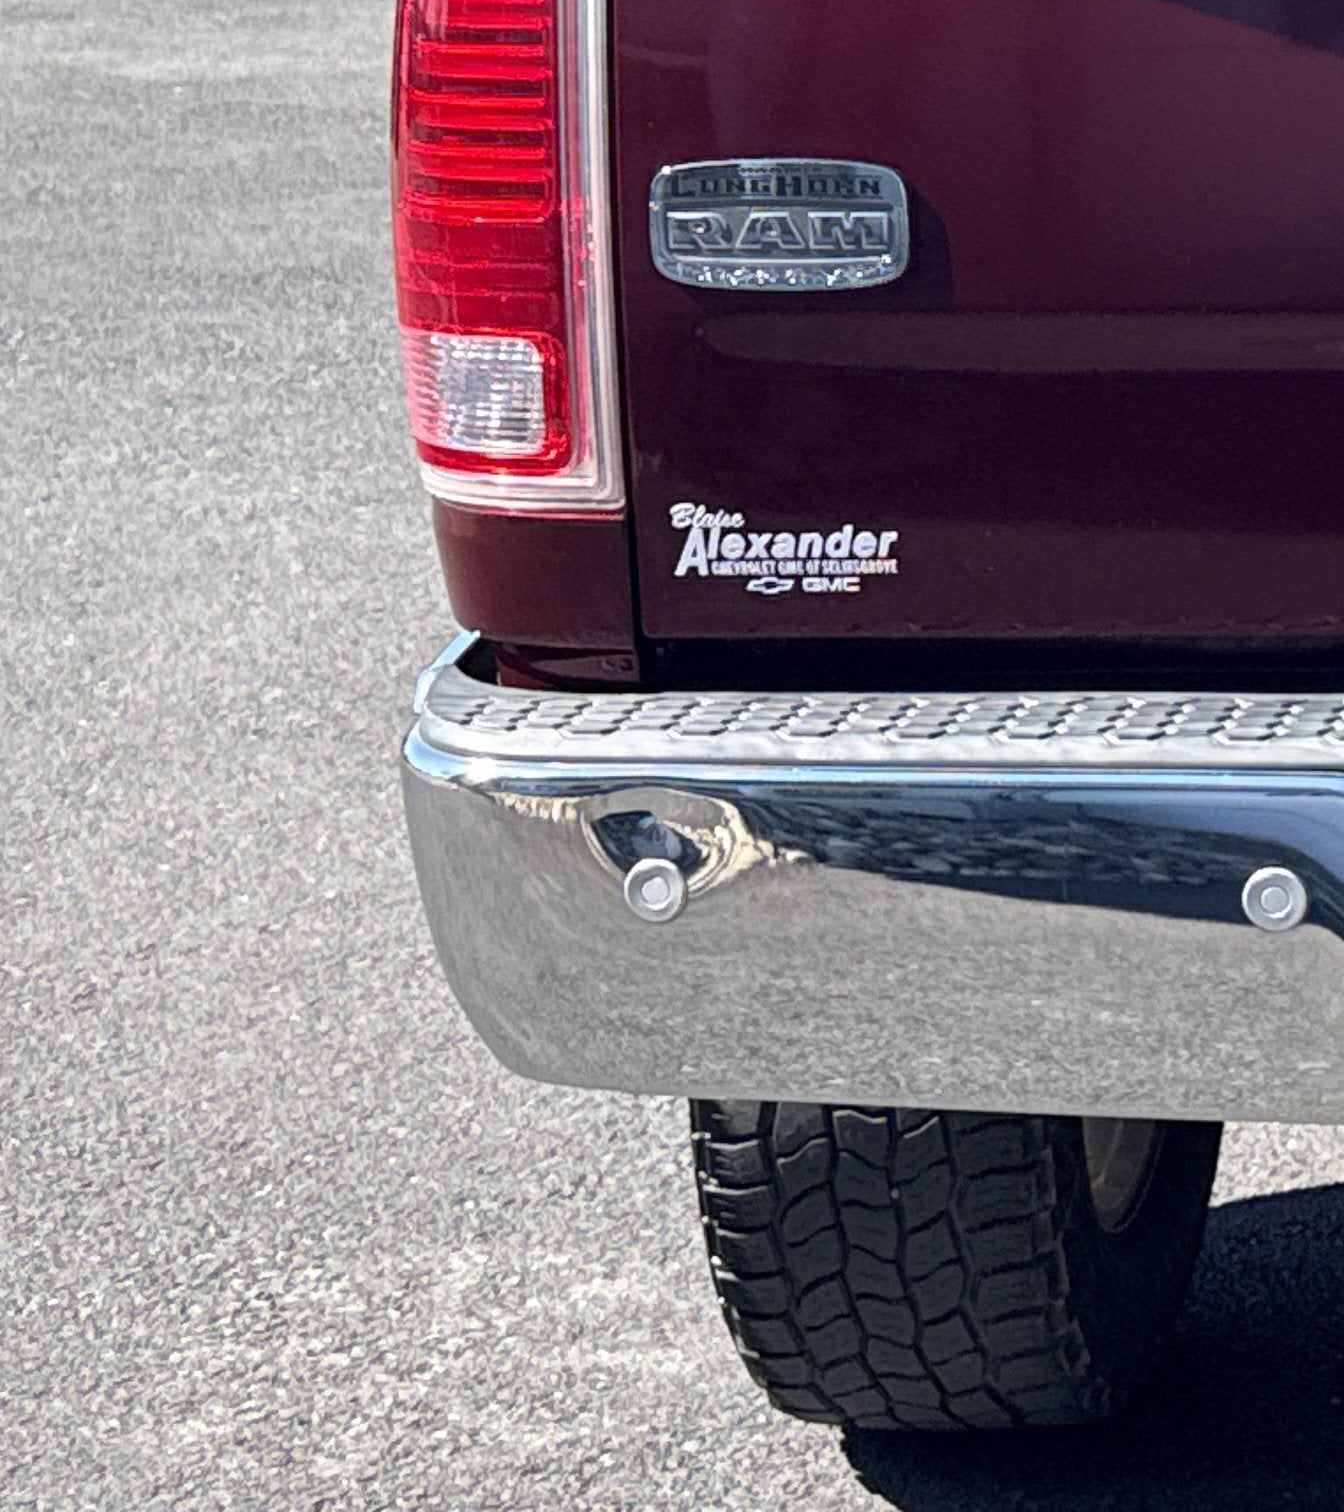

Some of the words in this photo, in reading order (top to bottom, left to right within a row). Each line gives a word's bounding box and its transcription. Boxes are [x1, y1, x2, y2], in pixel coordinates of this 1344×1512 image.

[666, 210, 892, 251] RAM
[669, 502, 746, 529] Blaise
[674, 523, 899, 577] Alexander
[801, 576, 861, 593] GMC
